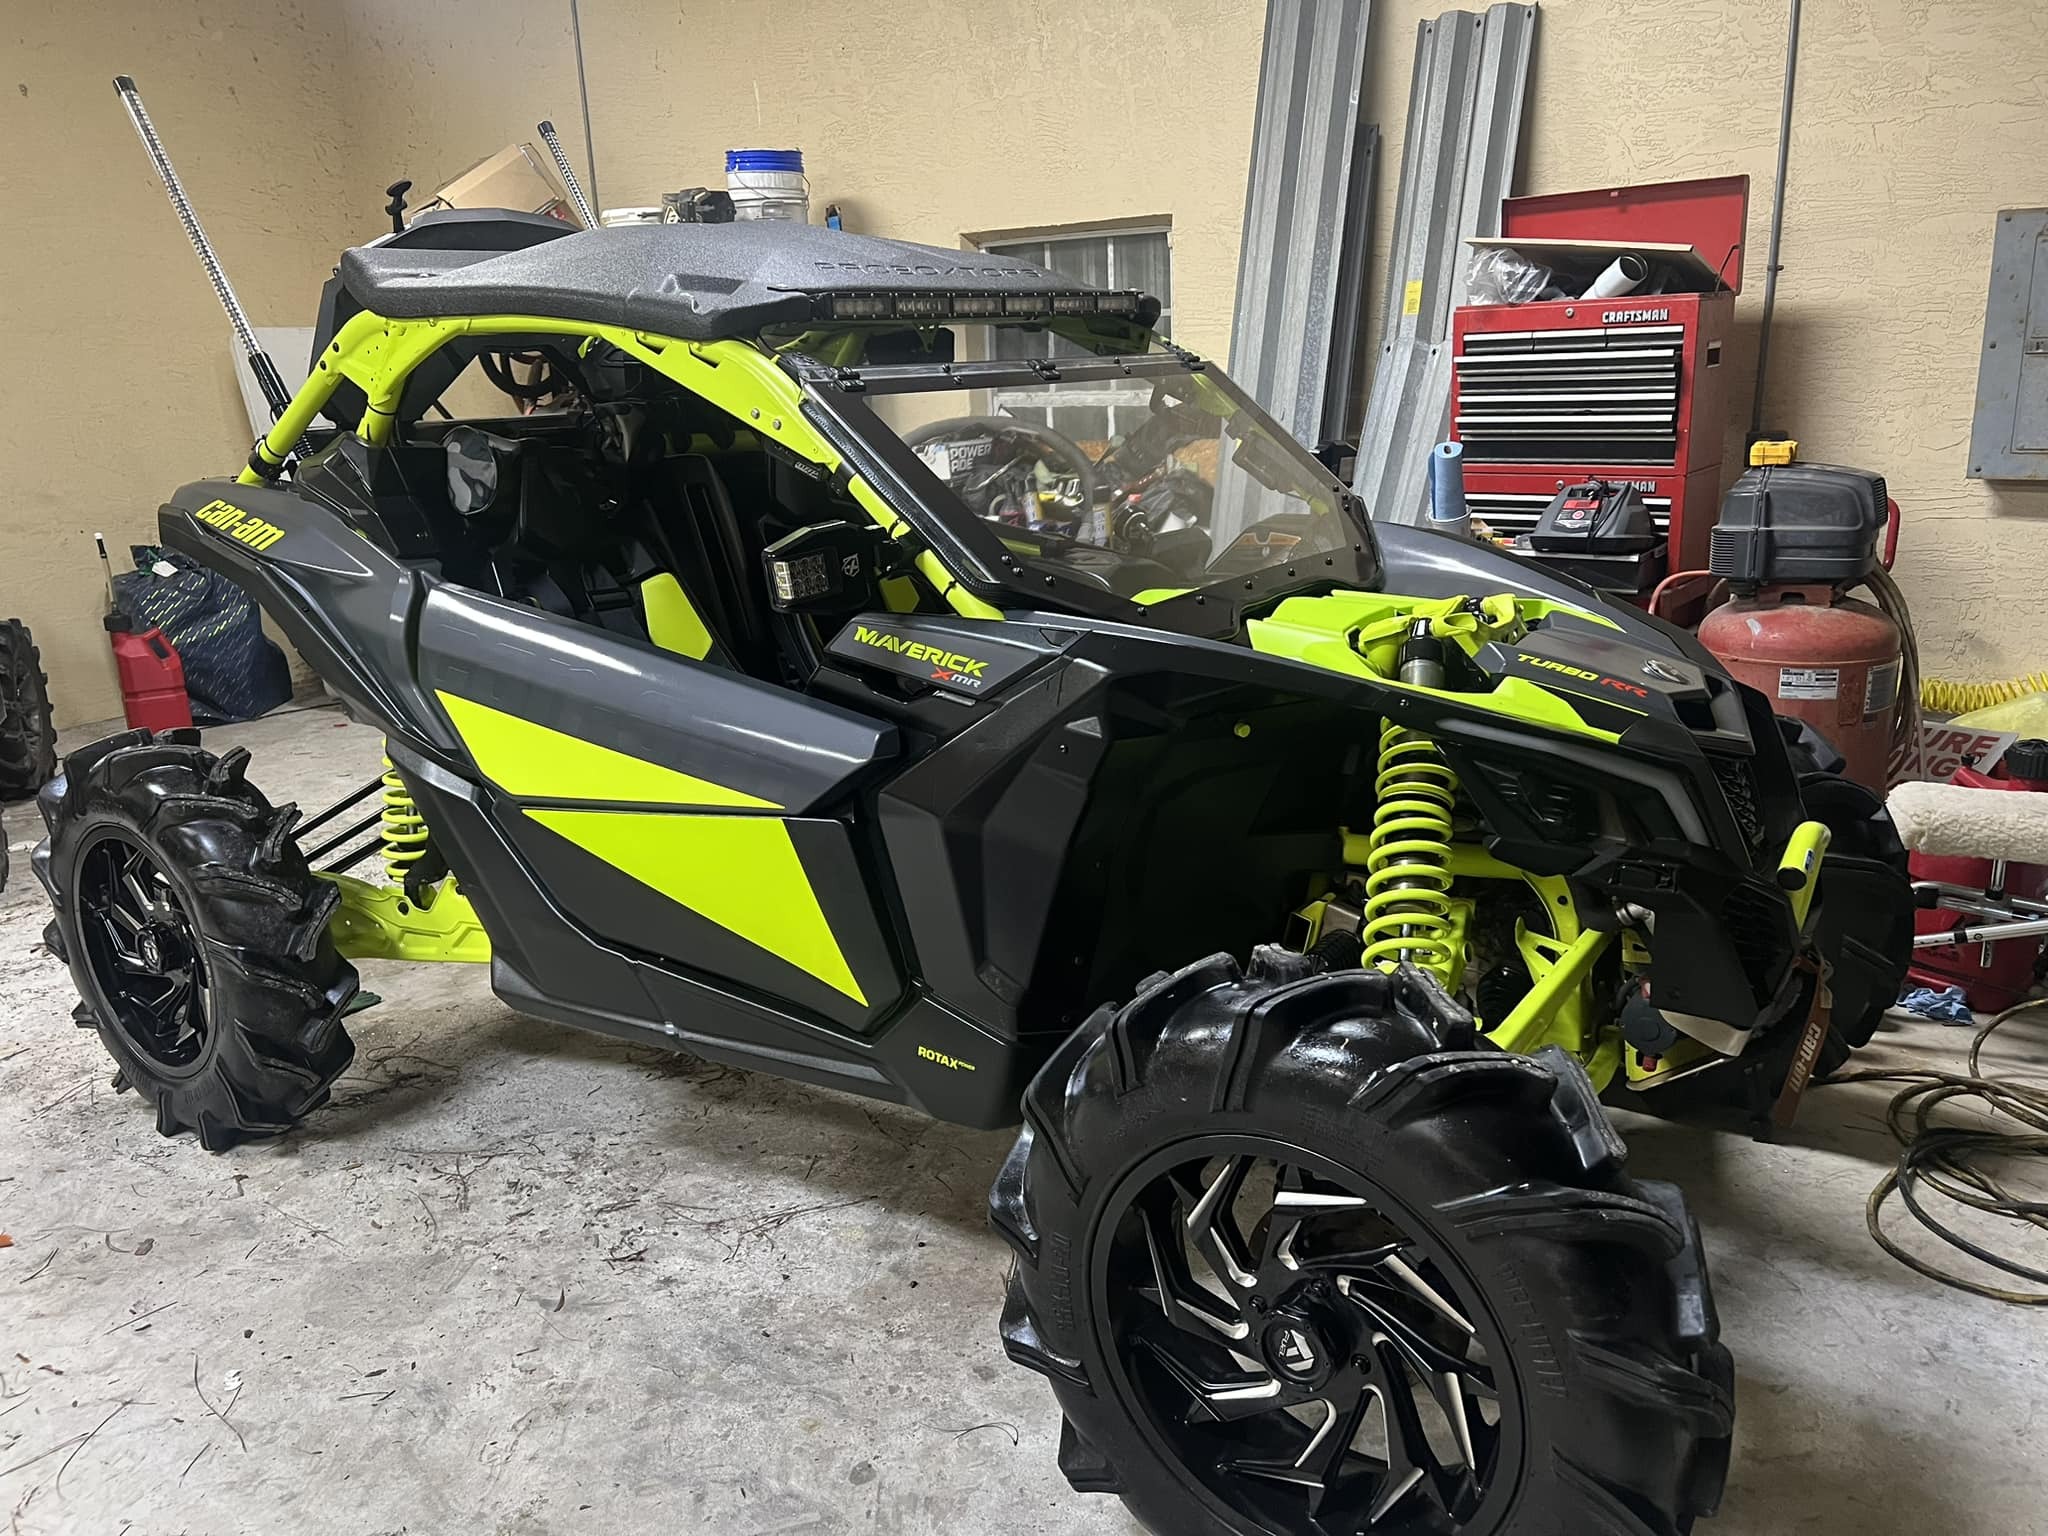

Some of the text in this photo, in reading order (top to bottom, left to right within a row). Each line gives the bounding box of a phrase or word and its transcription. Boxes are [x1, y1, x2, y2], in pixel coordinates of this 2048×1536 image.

[1602, 308, 1669, 324] CRAFTSMAN
[950, 443, 993, 460] POWER
[194, 499, 286, 551] can-am
[853, 625, 990, 678] MAVERICK
[1517, 653, 1600, 681] TURBO
[917, 1045, 958, 1071] ROTAX
[1278, 1329, 1291, 1358] FUEL
